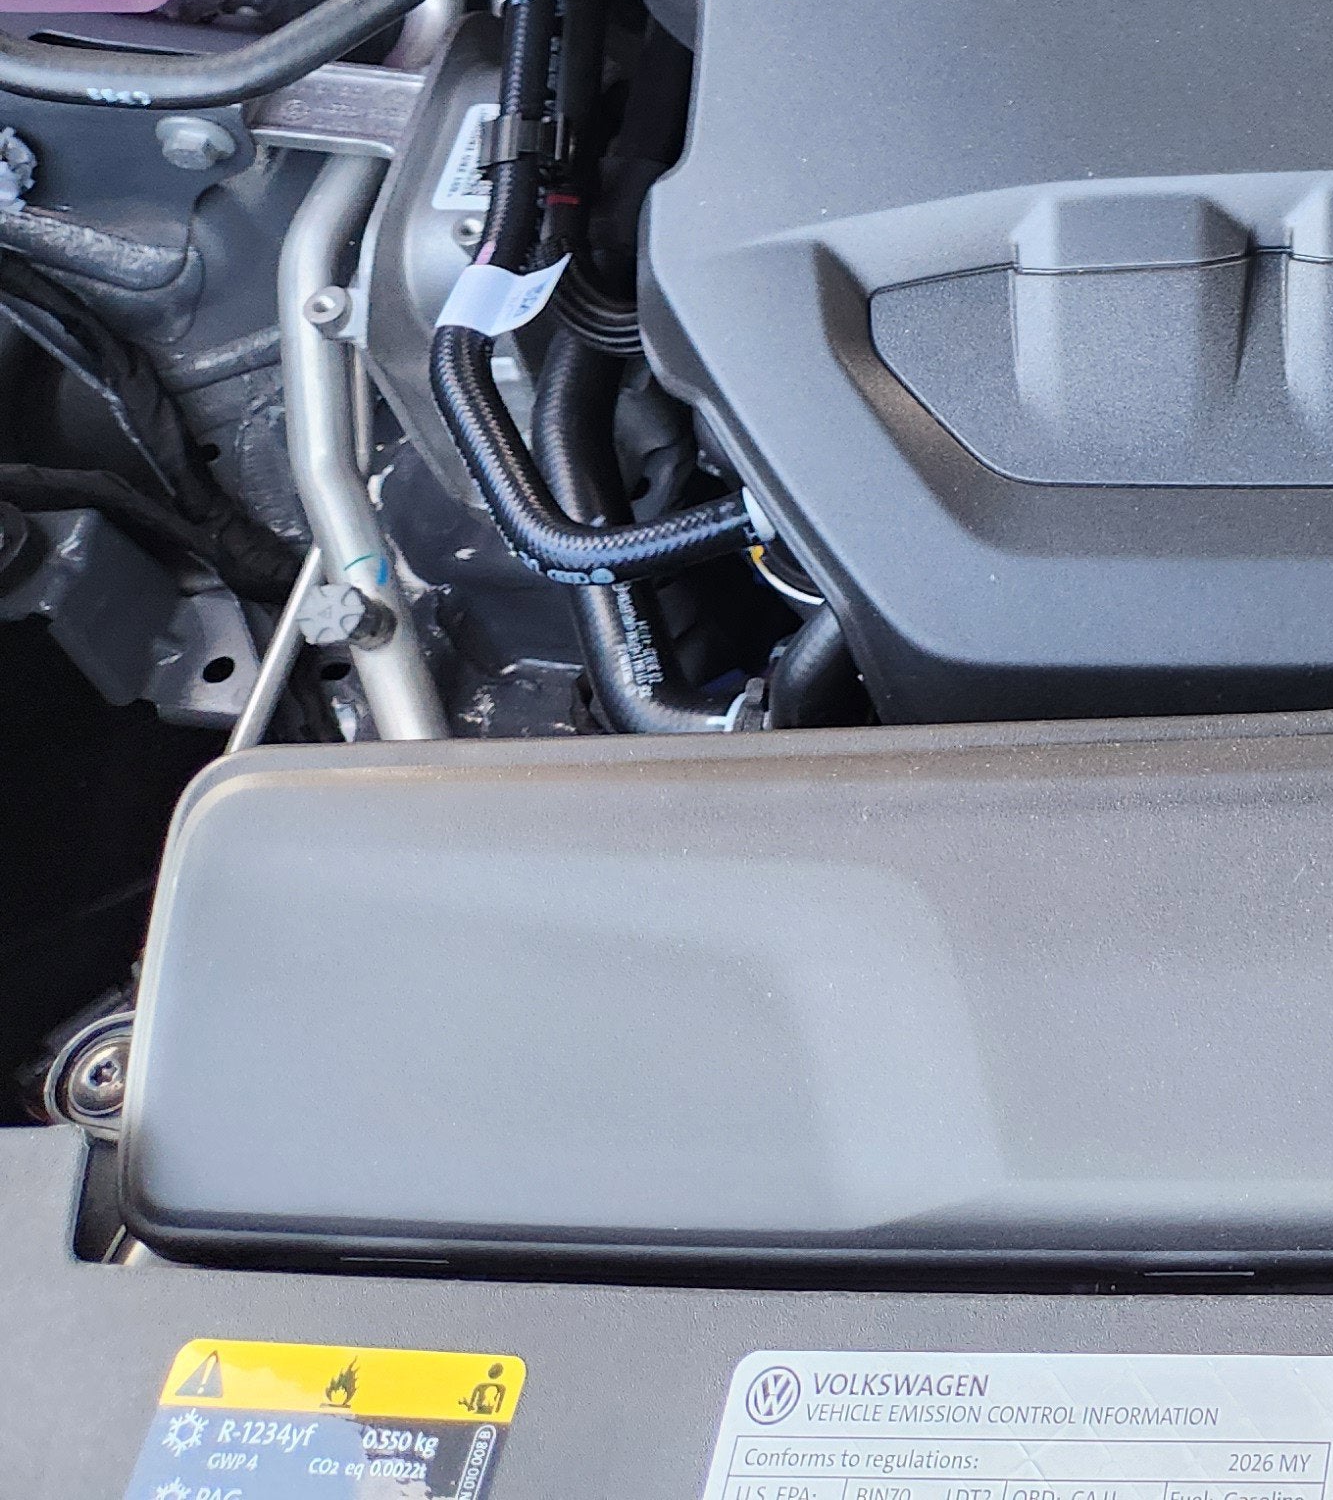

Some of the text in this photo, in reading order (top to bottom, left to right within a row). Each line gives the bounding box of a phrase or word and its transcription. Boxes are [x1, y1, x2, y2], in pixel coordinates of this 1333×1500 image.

[813, 1373, 989, 1397] VOLKSWAGEN
[806, 1403, 1219, 1426] VEHICLE EMISSION CONTROL INFORMATION
[217, 1419, 439, 1458] R-1234yf 0.550 kg
[207, 1452, 258, 1472] GWP 4
[345, 1462, 363, 1480] eq
[369, 1460, 426, 1480] 0.0022t
[744, 1448, 979, 1474] Conforms to regulations:
[1228, 1453, 1311, 1473] 2026 MY
